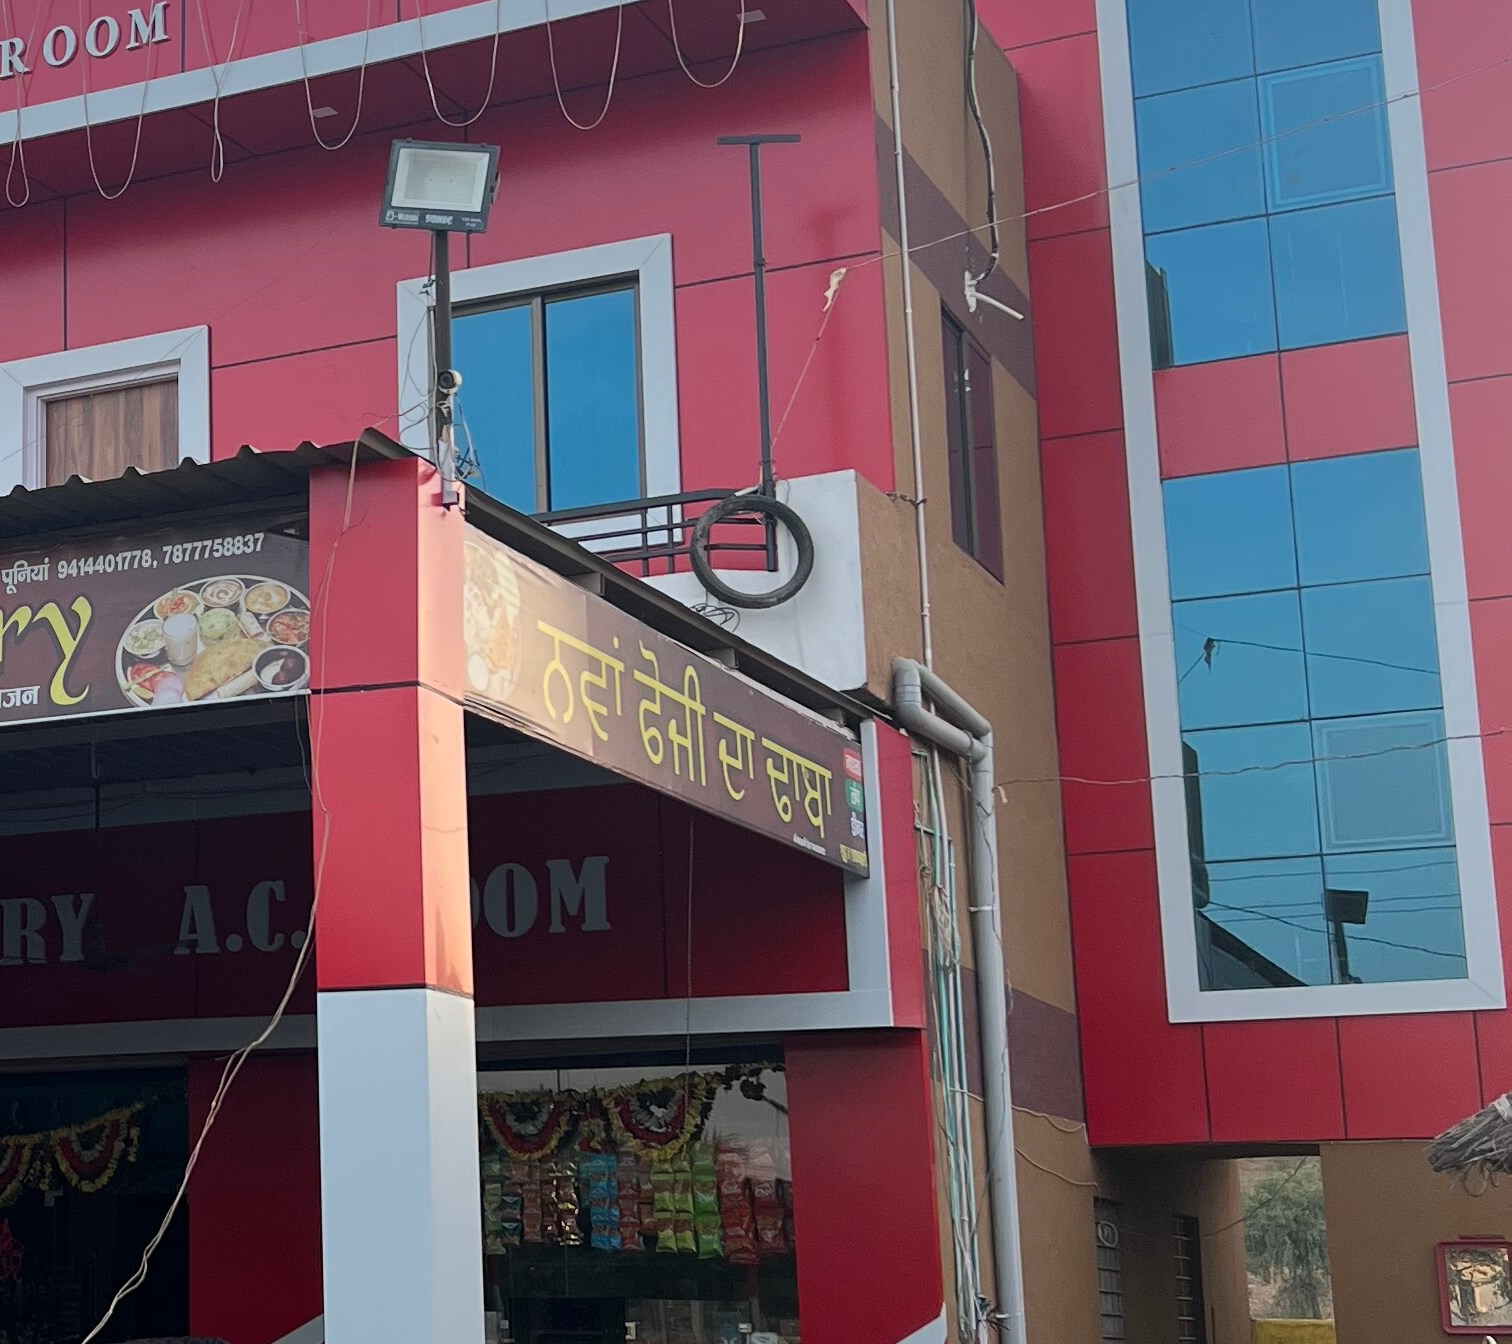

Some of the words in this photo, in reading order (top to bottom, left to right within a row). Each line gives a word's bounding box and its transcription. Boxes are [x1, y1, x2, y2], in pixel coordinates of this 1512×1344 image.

[1, 557, 50, 595] पूनियां
[57, 548, 158, 579] 9414401778,
[162, 532, 265, 565] 7877758837
[537, 619, 625, 742] ਨਵਾਂ
[713, 711, 756, 801] ਦਾ
[761, 736, 832, 839] ਢਾਬਾ
